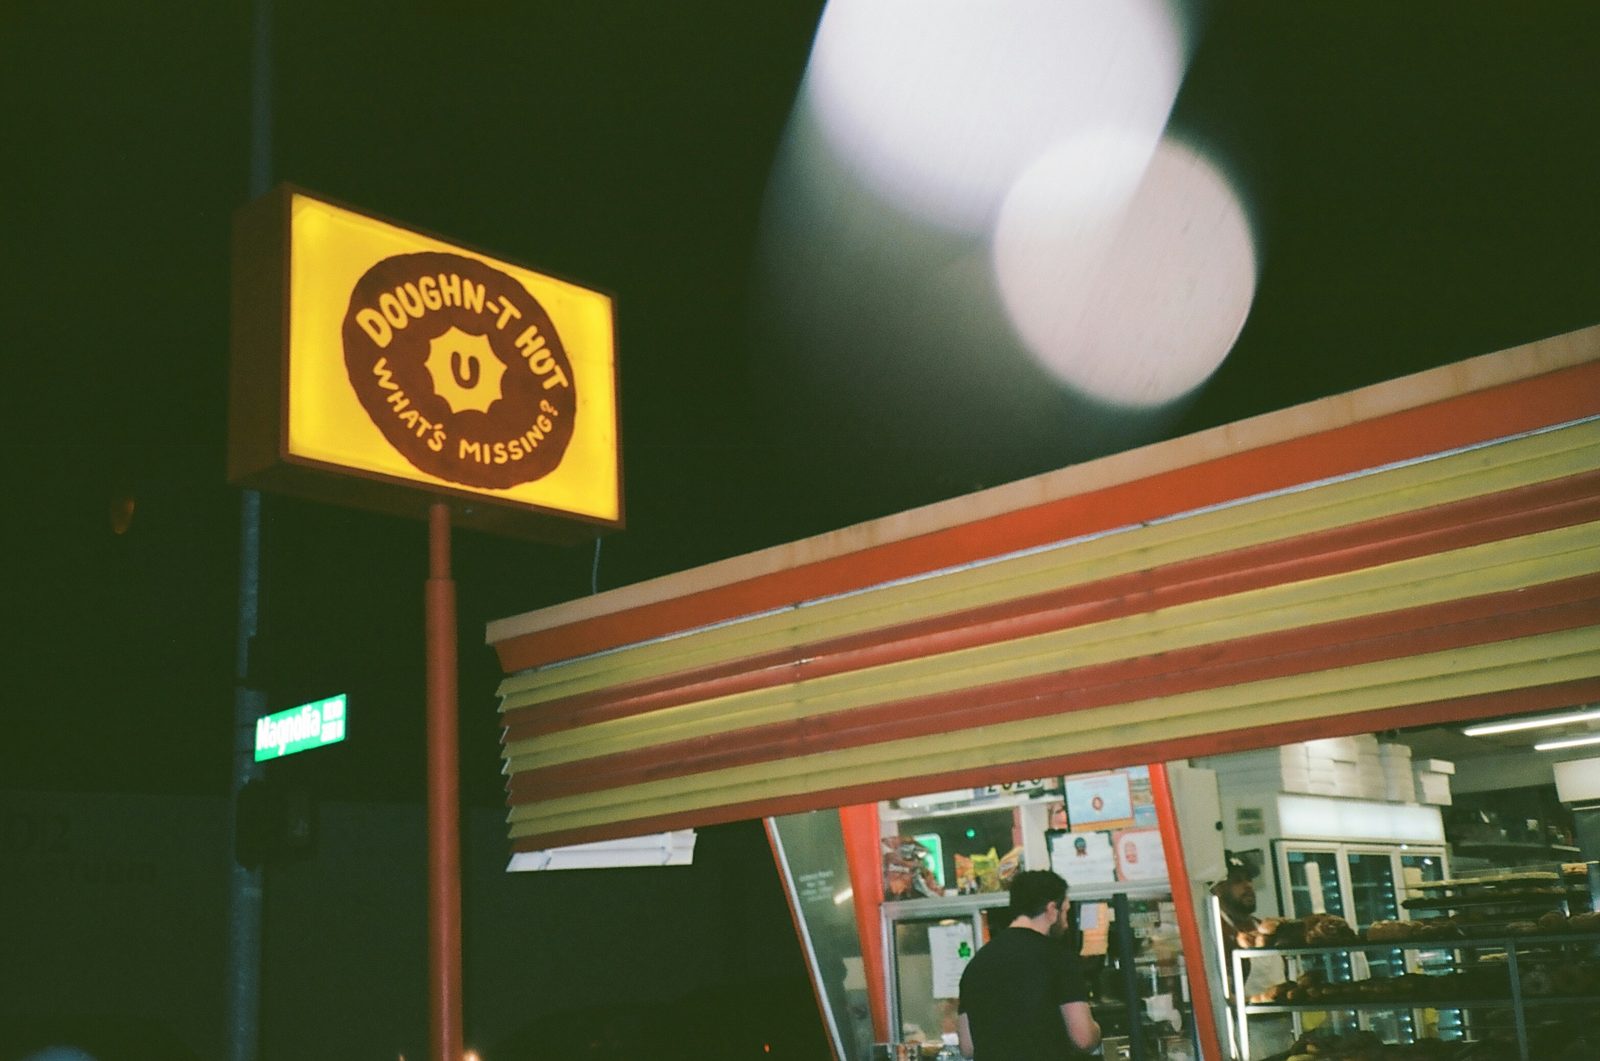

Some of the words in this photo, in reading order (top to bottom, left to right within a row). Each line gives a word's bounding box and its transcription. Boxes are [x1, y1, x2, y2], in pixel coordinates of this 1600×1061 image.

[356, 273, 522, 348] DOUGHN-T
[514, 324, 569, 390] HUT
[450, 351, 481, 390] U
[373, 357, 447, 452] WHAT'S
[459, 399, 559, 464] MISSING?
